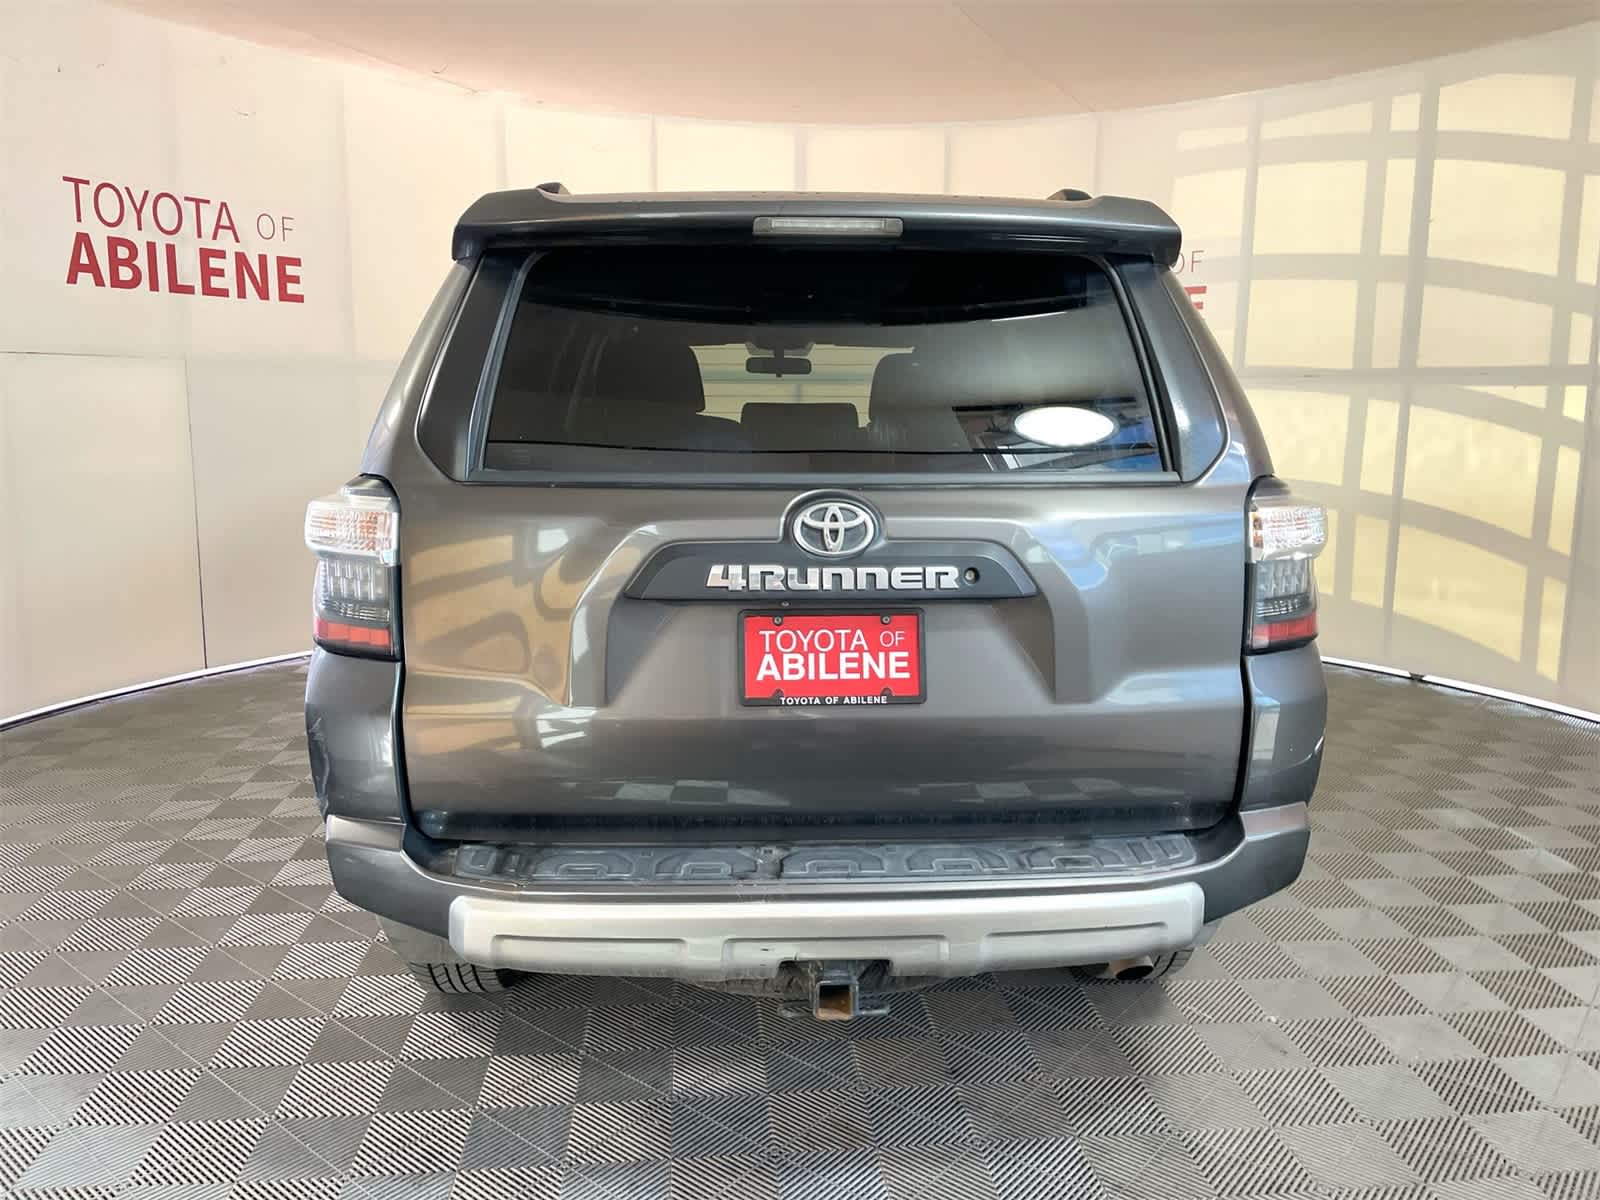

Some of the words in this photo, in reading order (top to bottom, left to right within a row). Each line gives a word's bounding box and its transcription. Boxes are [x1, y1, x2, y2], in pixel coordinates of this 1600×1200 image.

[62, 175, 241, 244] TOYOTA
[256, 213, 295, 242] OF
[65, 231, 305, 304] ABILENE
[759, 629, 868, 651] TOYOTA
[879, 630, 905, 648] OF
[756, 652, 910, 681] ABILENE
[780, 696, 821, 705] TOYOTA
[825, 696, 839, 705] OF
[843, 695, 888, 705] ABILENE
